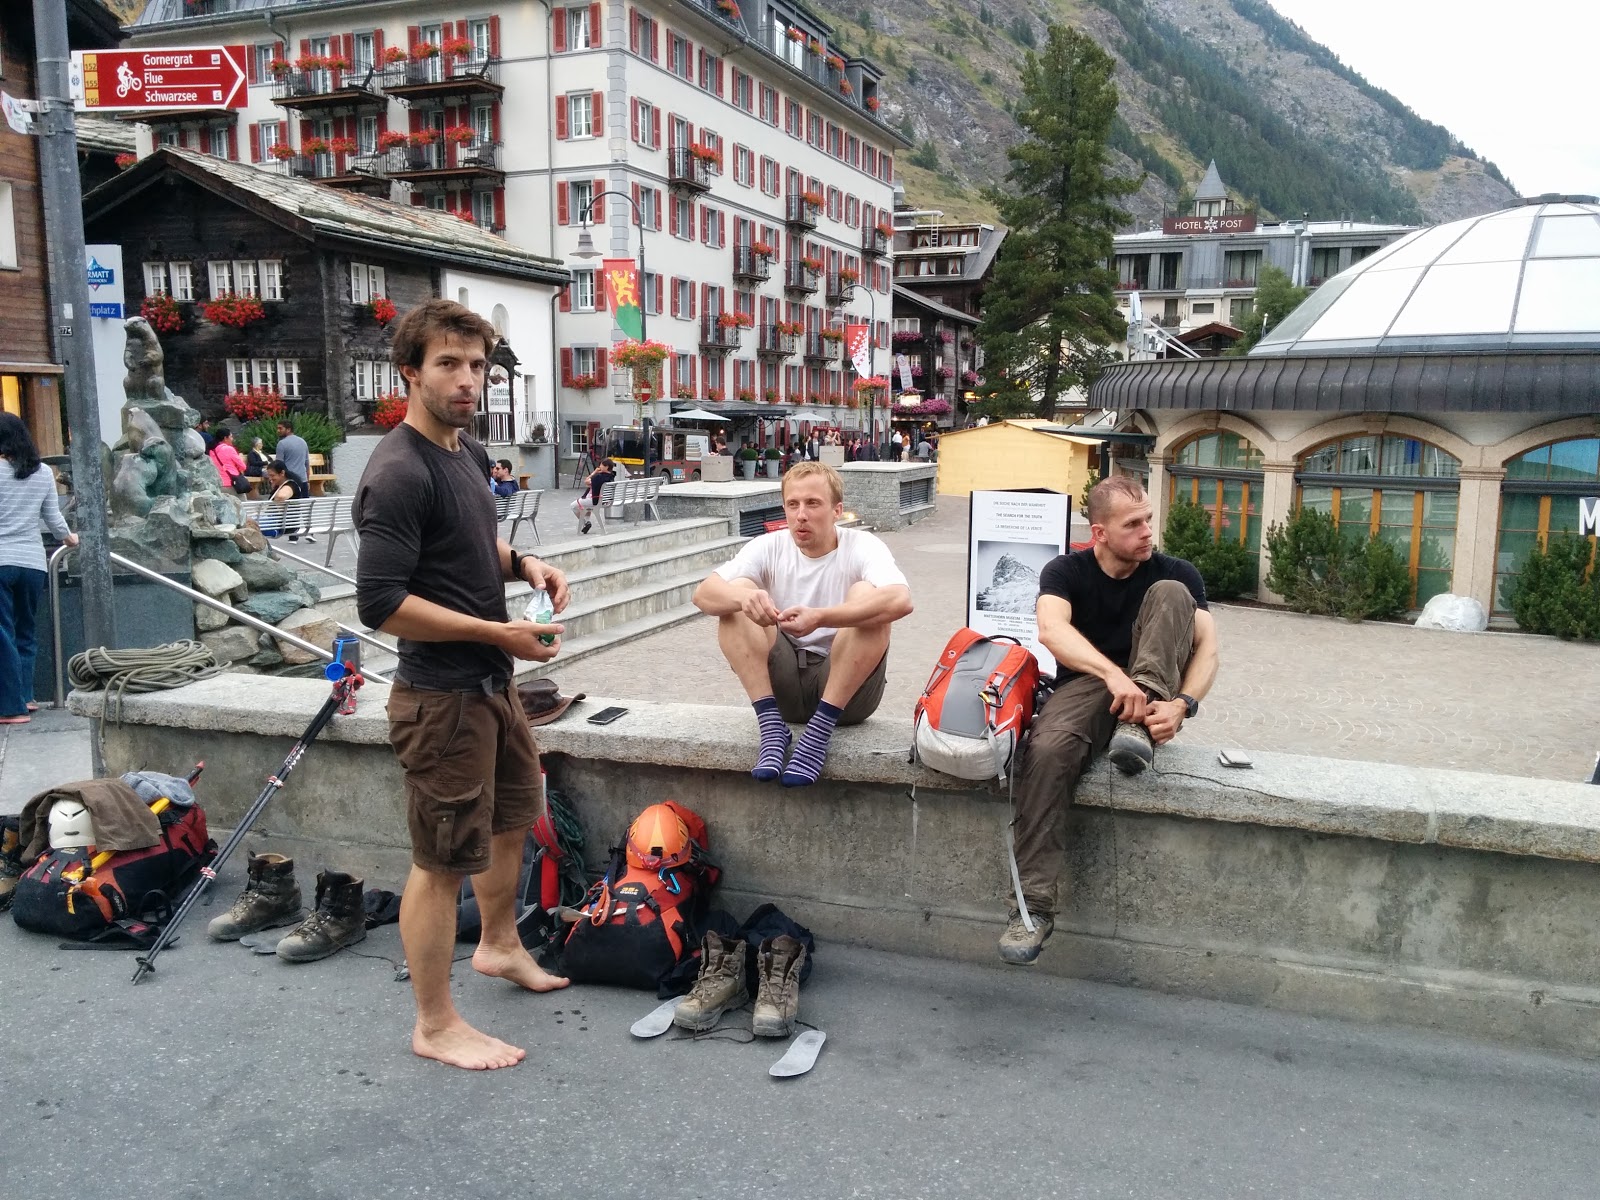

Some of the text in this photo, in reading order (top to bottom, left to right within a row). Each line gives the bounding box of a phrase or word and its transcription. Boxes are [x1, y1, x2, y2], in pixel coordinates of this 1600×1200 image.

[143, 54, 193, 67] Gornergrat
[144, 72, 163, 84] Flue
[145, 90, 198, 102] Schwarzsee
[1174, 219, 1243, 230] HOTEL POST
[91, 305, 115, 317] hplatz
